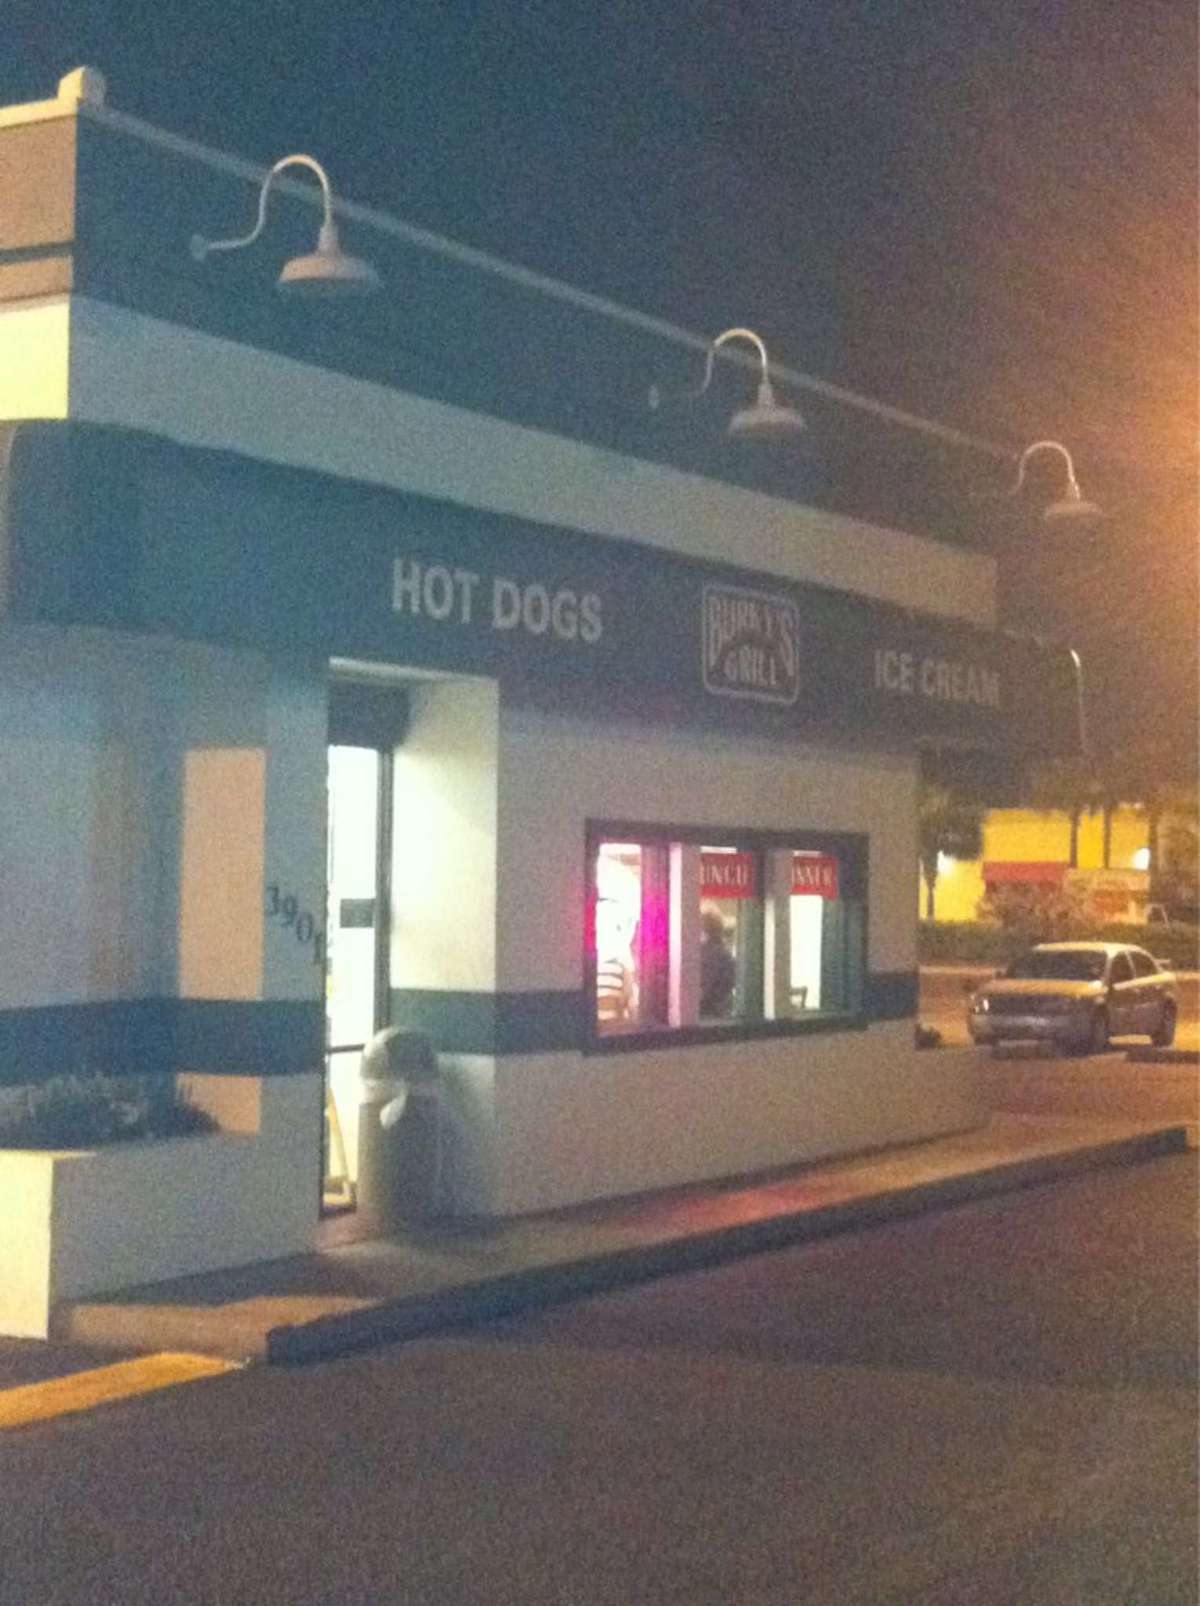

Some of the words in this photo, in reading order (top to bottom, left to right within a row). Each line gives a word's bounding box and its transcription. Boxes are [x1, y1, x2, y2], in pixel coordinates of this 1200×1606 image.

[393, 557, 480, 624] HOT
[493, 578, 602, 643] DOGS
[723, 646, 778, 687] GRILL
[875, 649, 912, 691] ICE
[920, 658, 1000, 706] CREAM
[700, 864, 748, 886] UNCH
